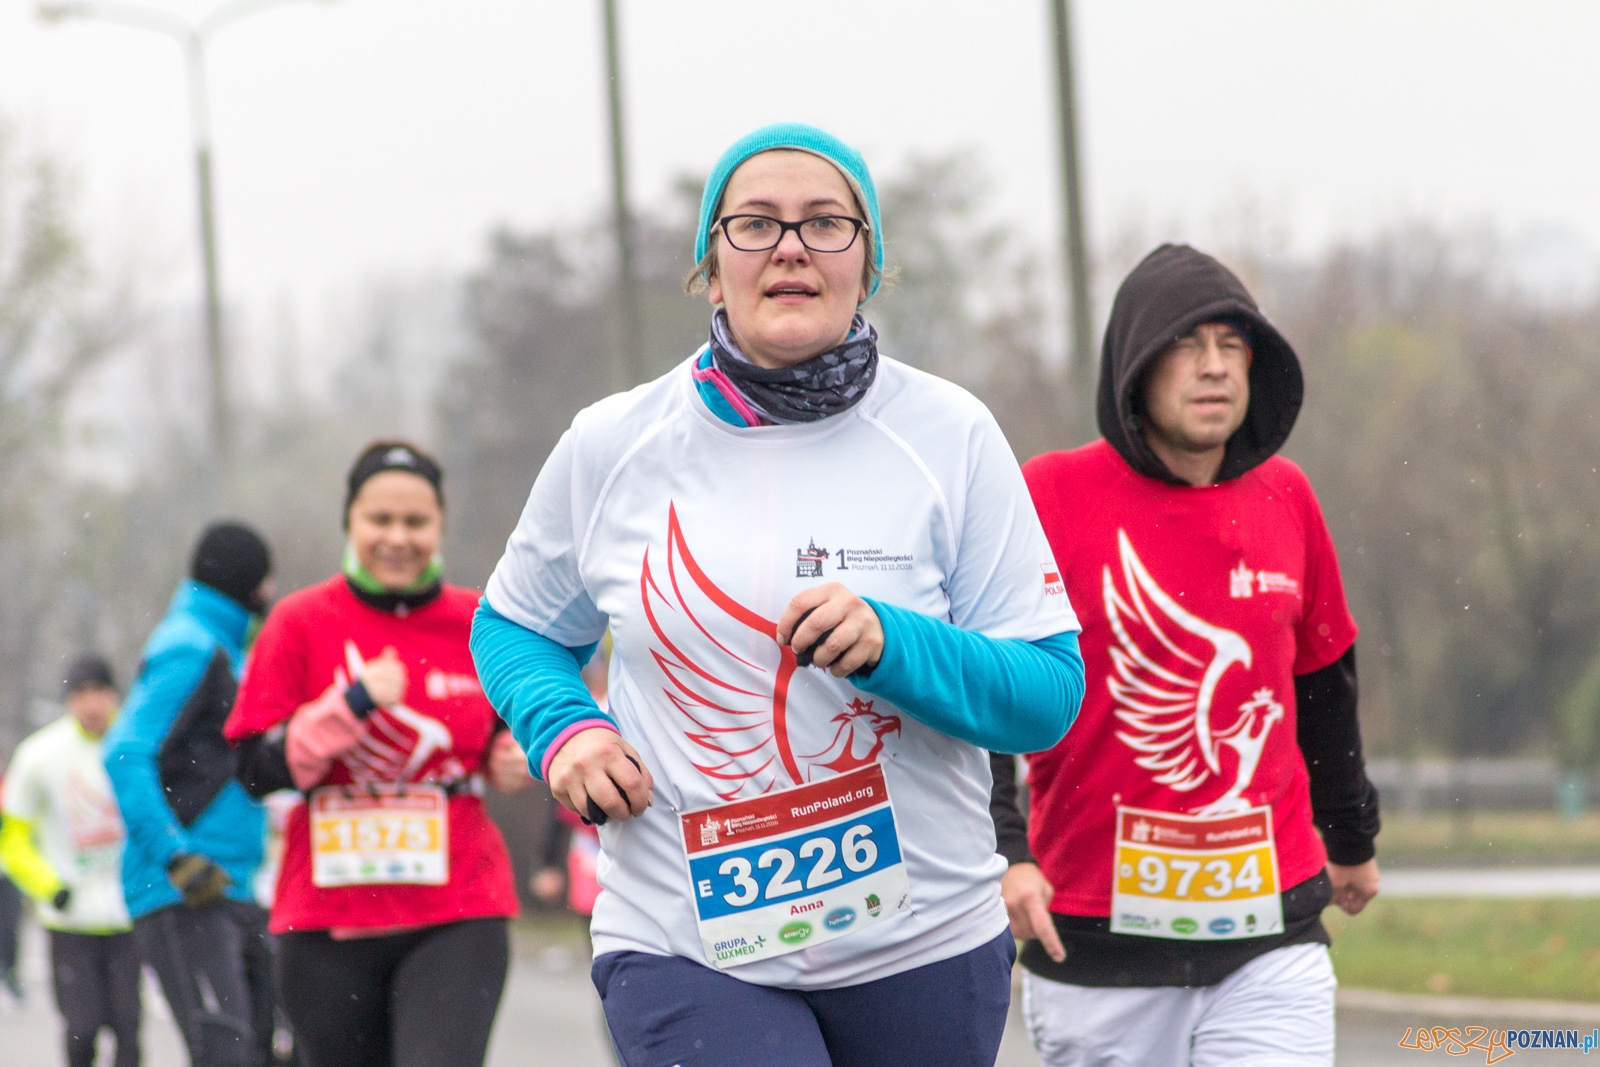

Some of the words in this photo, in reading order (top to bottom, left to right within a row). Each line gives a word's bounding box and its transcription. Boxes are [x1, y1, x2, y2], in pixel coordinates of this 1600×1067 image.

[835, 548, 849, 570] 1
[863, 554, 914, 562] Niepodległości
[790, 785, 874, 818] RunPoland.org
[332, 819, 431, 850] 1575
[723, 818, 735, 837] 1
[697, 878, 714, 898] E
[718, 823, 878, 908] 3226
[1138, 854, 1263, 899] 9734
[790, 899, 824, 916] Anna
[714, 937, 748, 952] GRUPA
[716, 945, 756, 961] LUXMED
